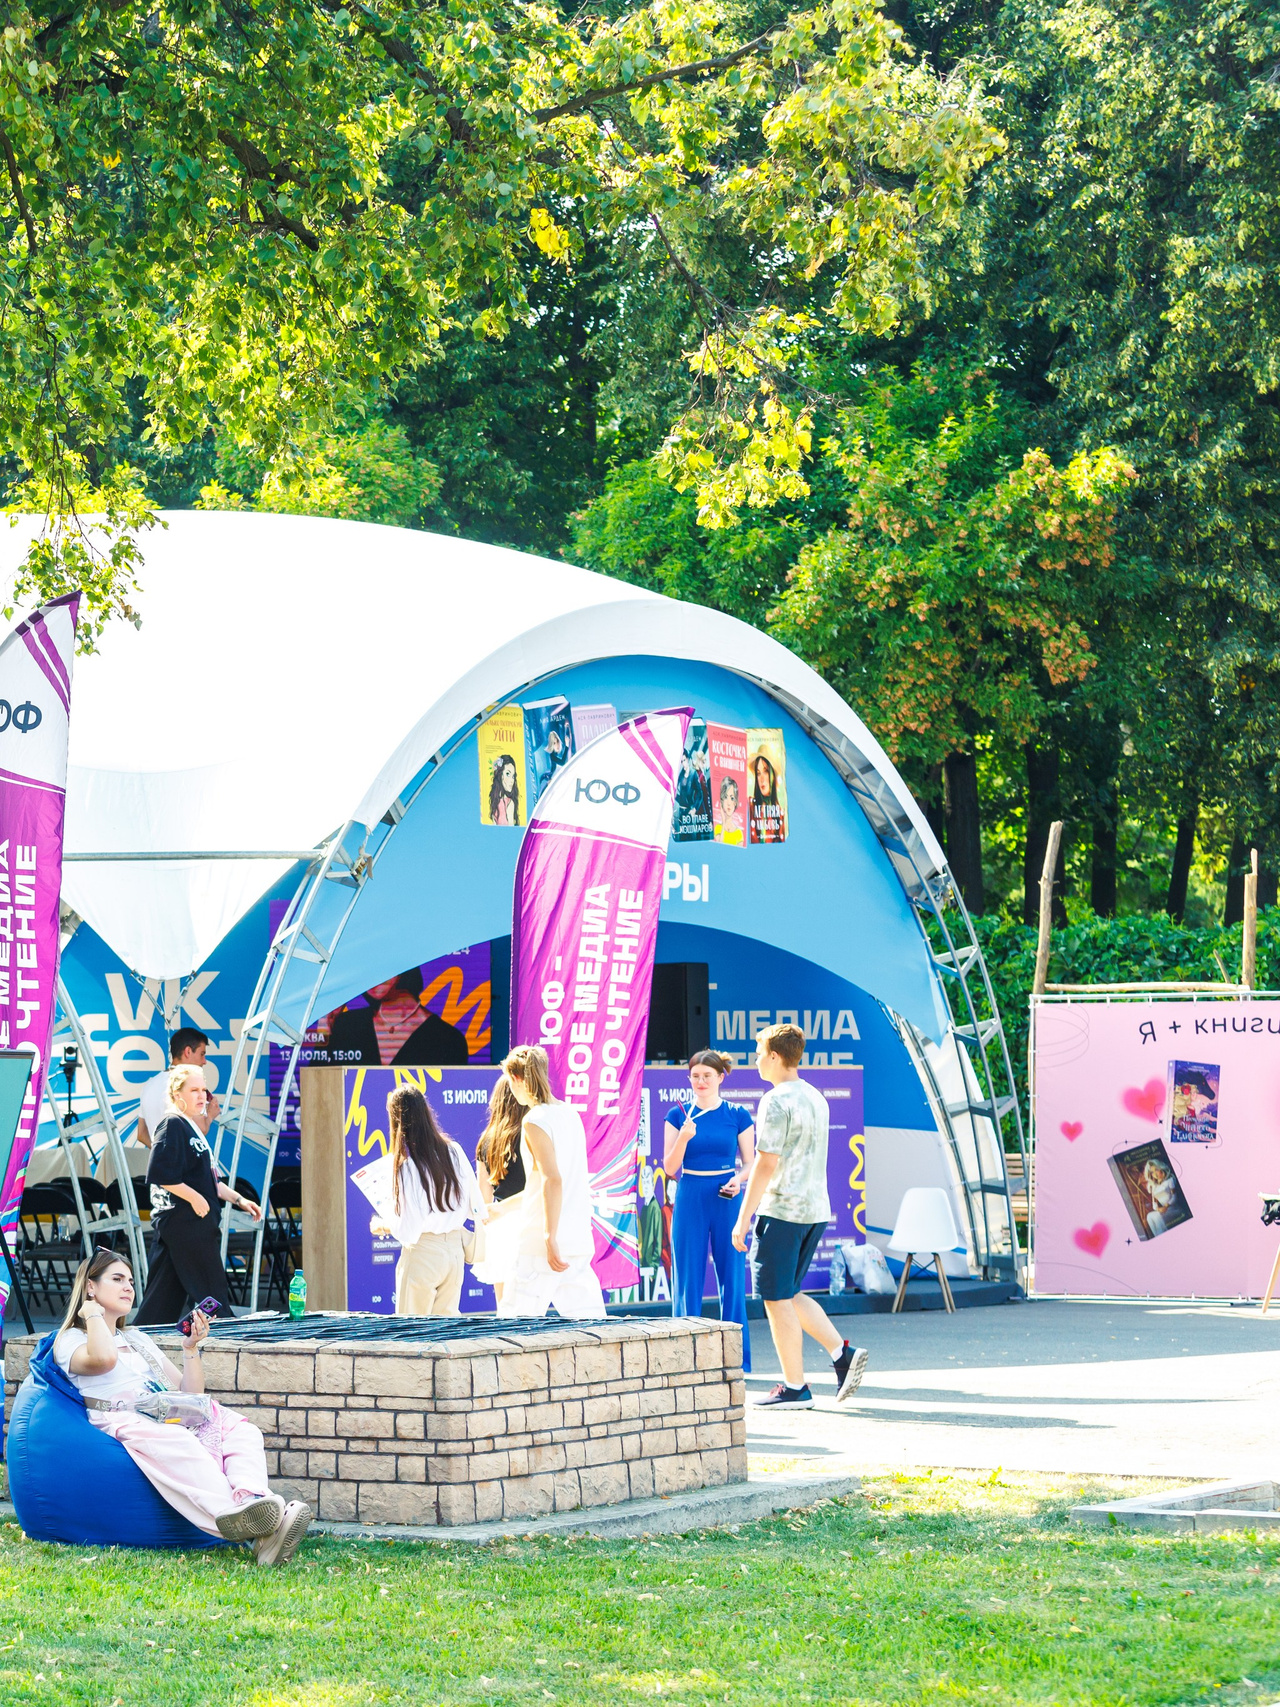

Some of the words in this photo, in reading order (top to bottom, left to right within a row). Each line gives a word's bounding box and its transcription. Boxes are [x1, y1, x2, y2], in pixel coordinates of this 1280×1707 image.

[712, 740, 747, 760] КОСТОЧКА
[714, 756, 719, 767] С
[575, 777, 641, 806] ЮФ
[679, 822, 713, 834] КОШМАРОВ
[682, 815, 690, 823] ВО
[15, 844, 41, 1030] ЧТЕНИЕ
[573, 883, 611, 1012] МЕДИА
[605, 888, 644, 1030] ЧТЕНИЕ
[104, 971, 222, 1031] VK
[539, 980, 566, 1045] ЮФ
[1138, 1020, 1157, 1045] Я
[1195, 1017, 1280, 1034] книги
[280, 1050, 291, 1061] 13
[333, 1050, 362, 1061] 15:00
[565, 1022, 595, 1112] ТВОЕ
[597, 1037, 627, 1116] ПРО
[442, 1089, 454, 1104] 13
[454, 1089, 488, 1104] ИЮЛЯ
[658, 1088, 669, 1102] 14
